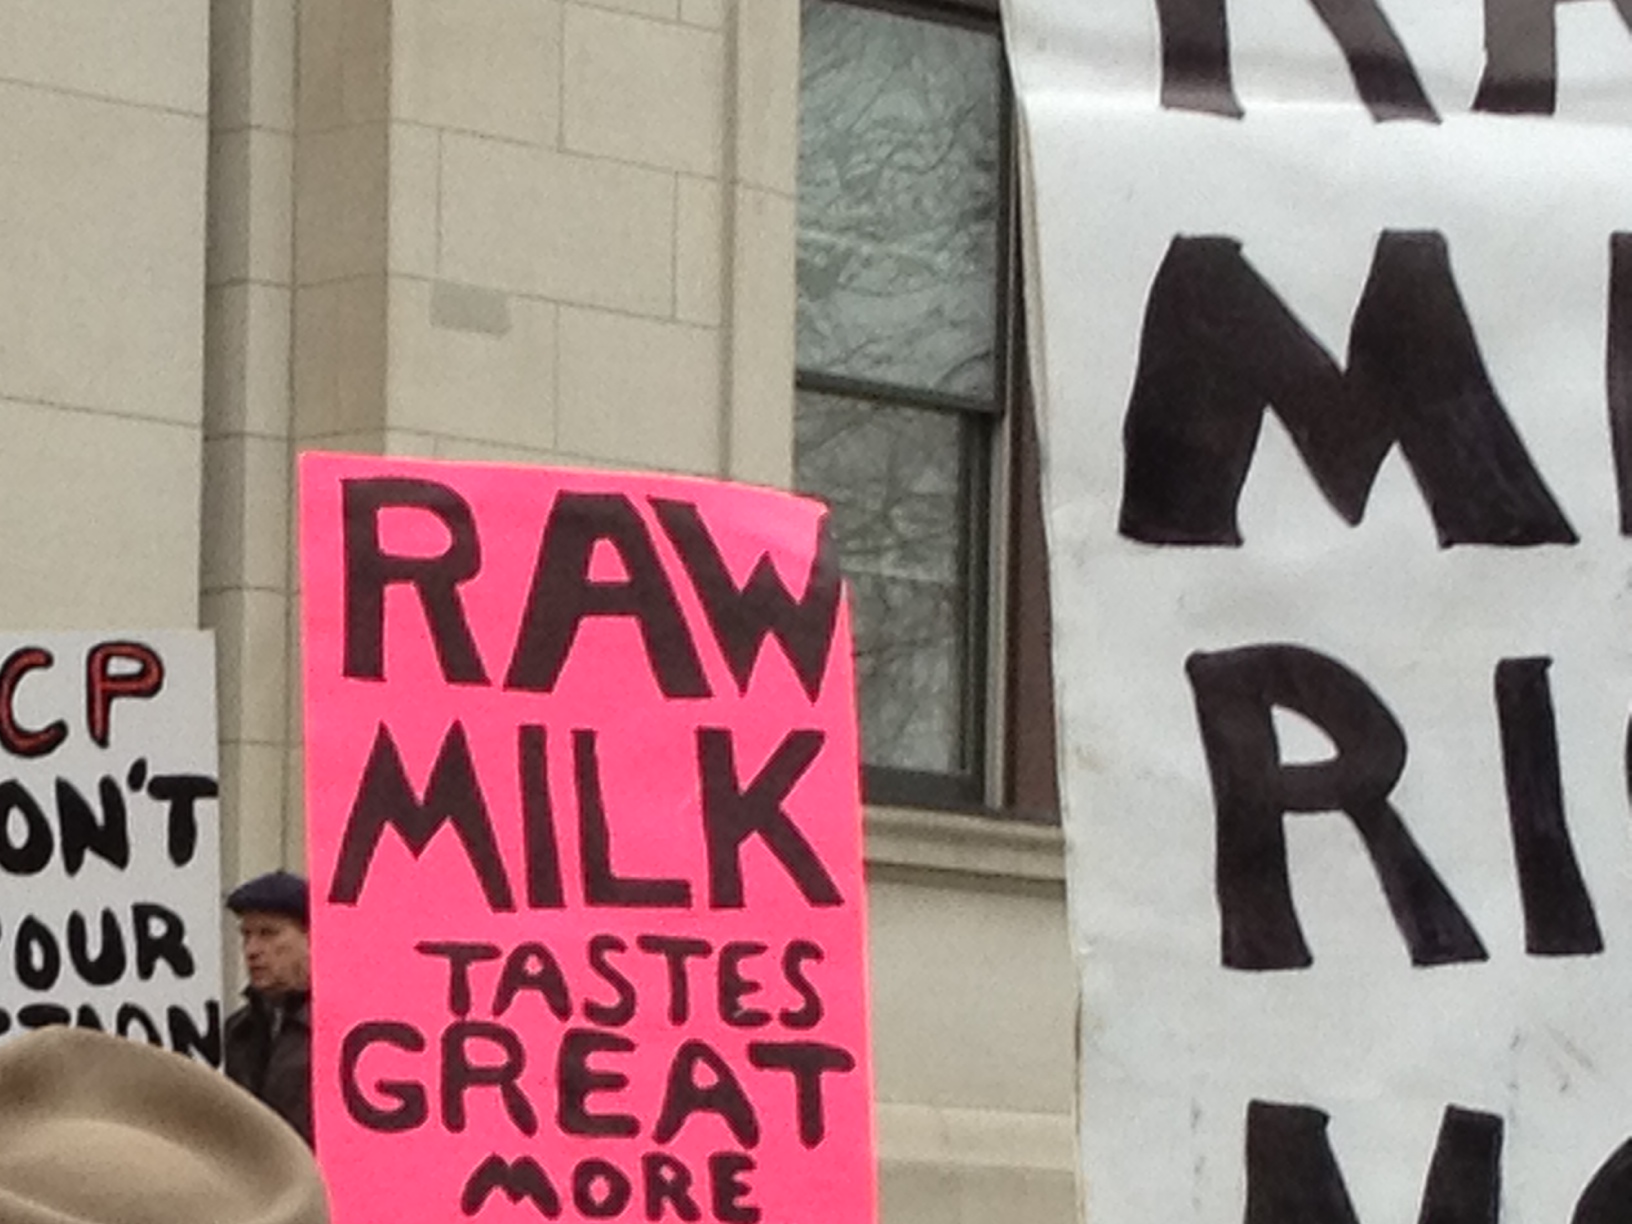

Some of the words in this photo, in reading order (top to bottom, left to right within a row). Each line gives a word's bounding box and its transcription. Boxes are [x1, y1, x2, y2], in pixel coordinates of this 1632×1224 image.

[340, 476, 846, 706] RAW
[327, 719, 845, 913] MILK
[414, 935, 824, 1029] TASTES
[338, 1020, 856, 1149] GREAT
[461, 1152, 762, 1224] MORE
